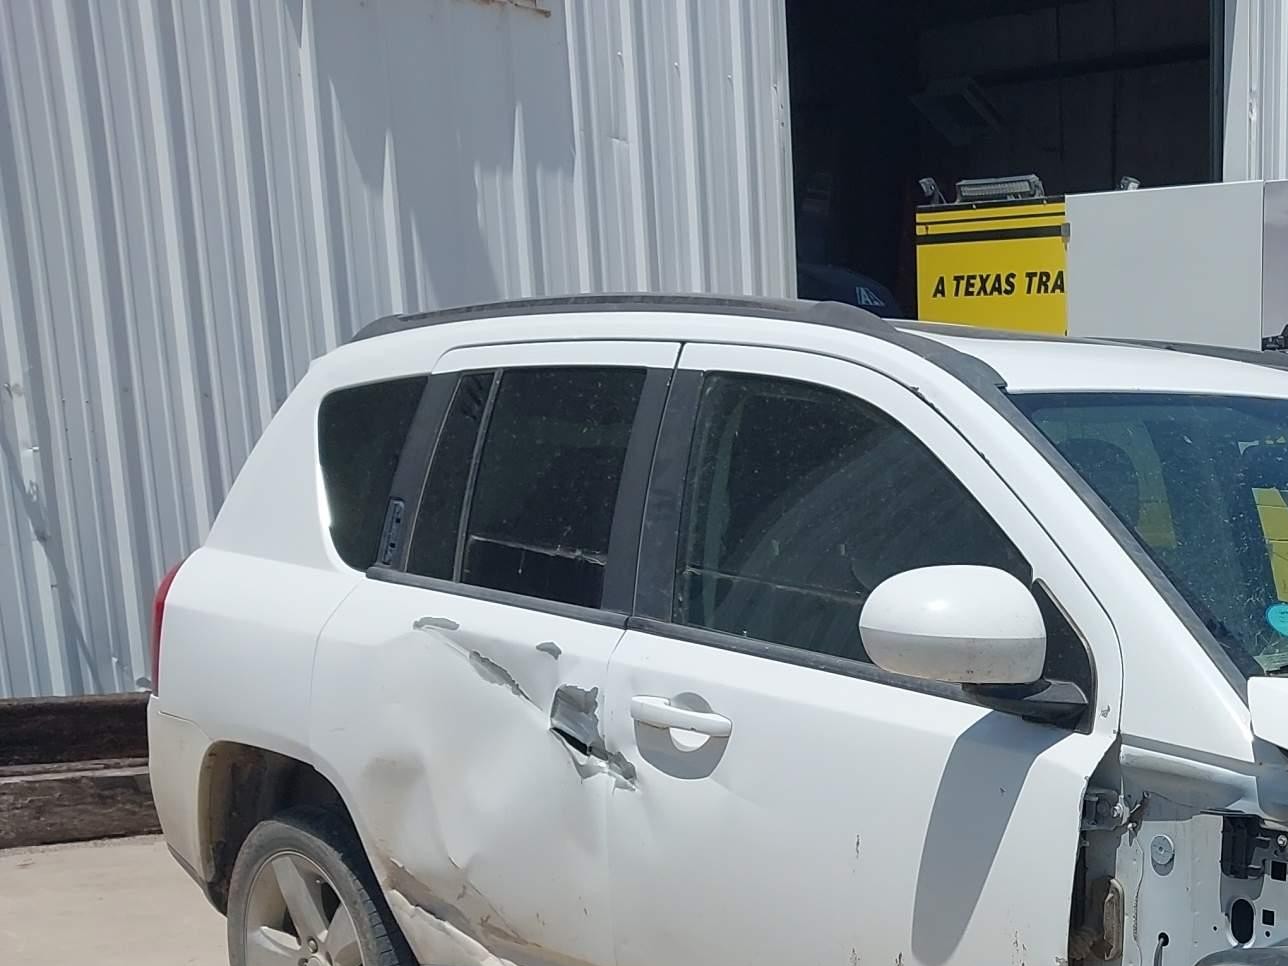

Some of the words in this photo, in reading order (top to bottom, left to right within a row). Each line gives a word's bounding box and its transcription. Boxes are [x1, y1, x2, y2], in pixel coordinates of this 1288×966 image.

[932, 276, 946, 298] A
[953, 272, 1016, 297] TEXAS
[1025, 270, 1065, 294] TRA
